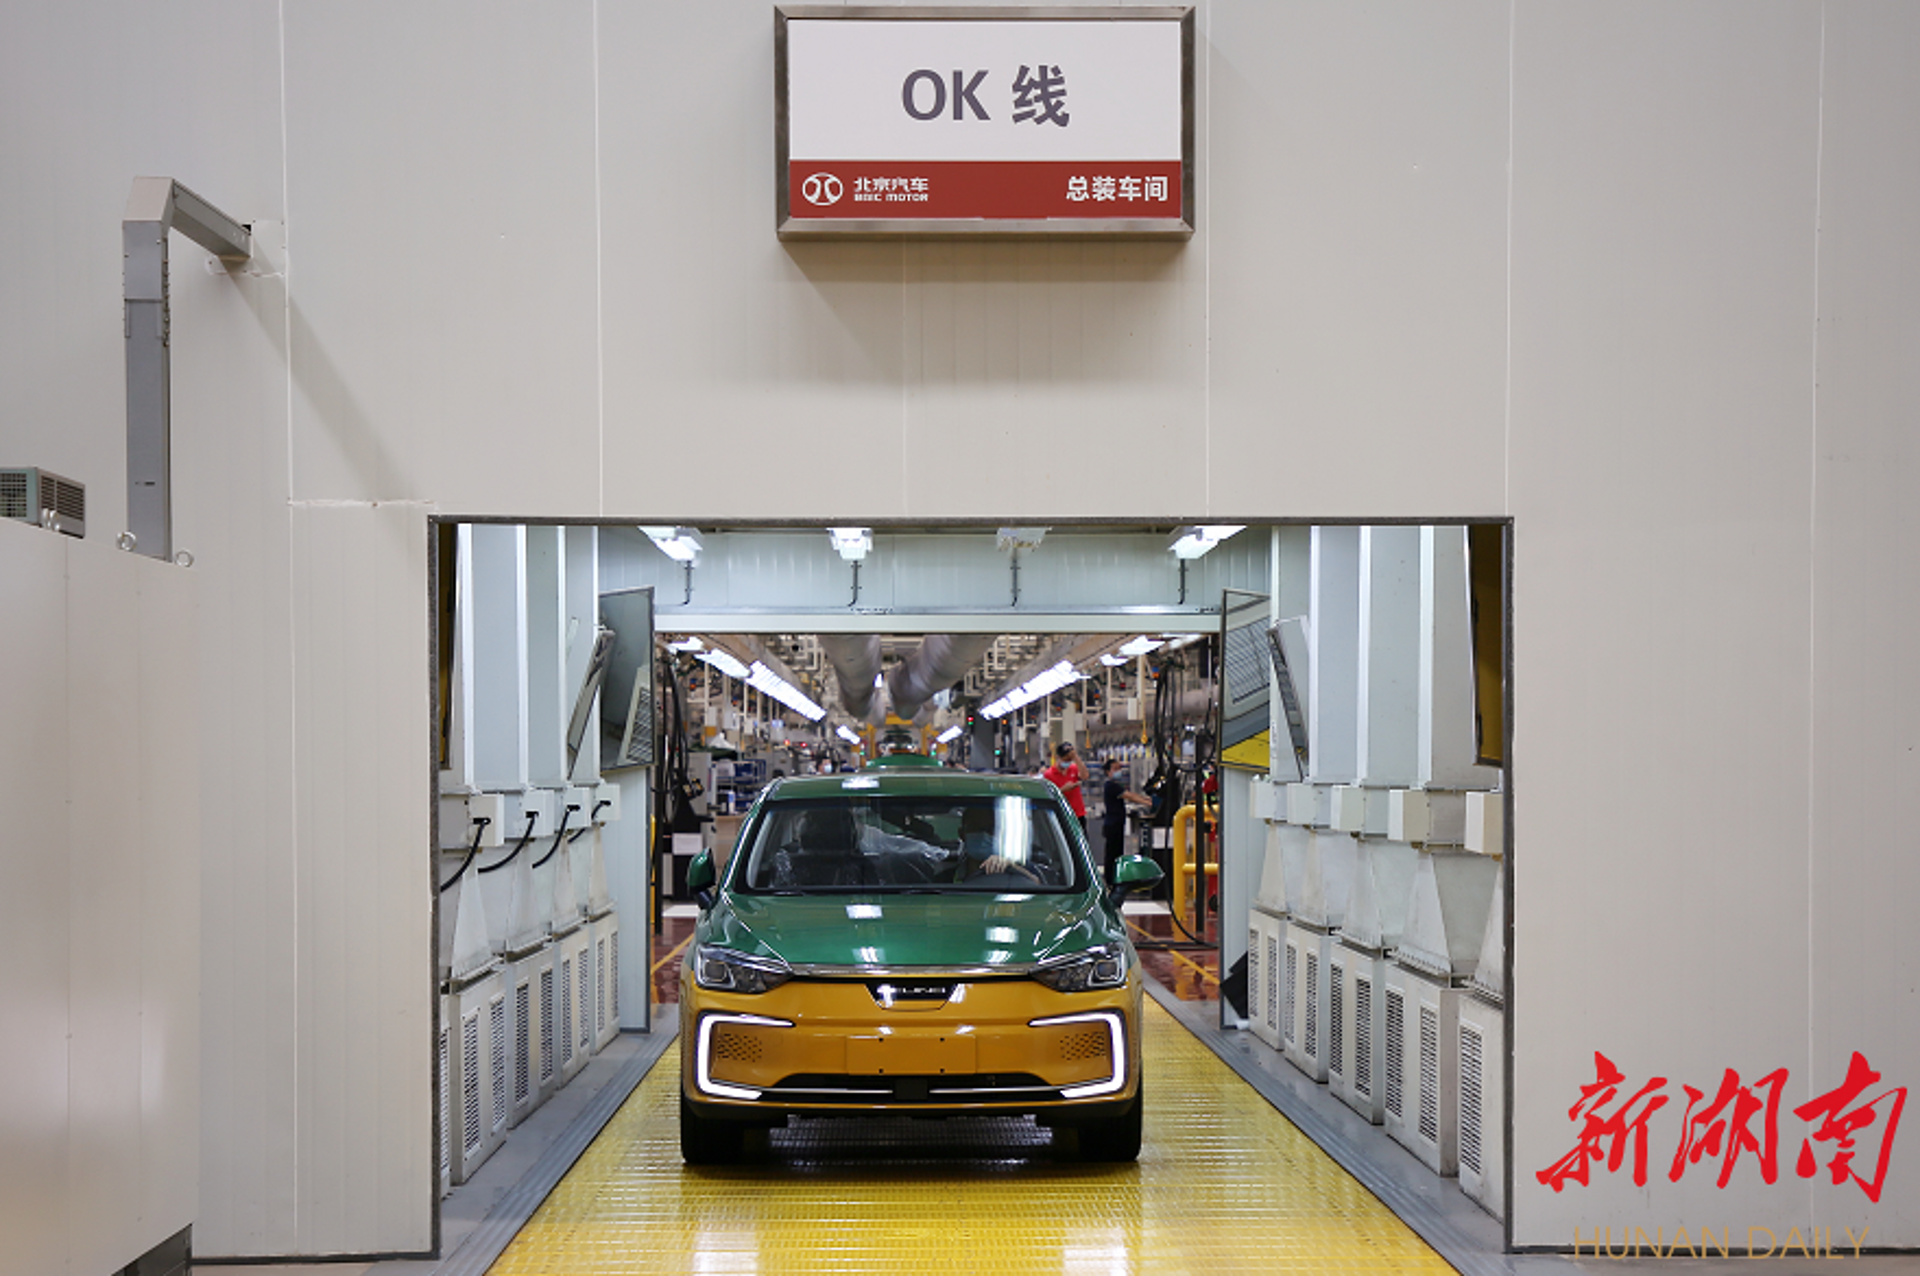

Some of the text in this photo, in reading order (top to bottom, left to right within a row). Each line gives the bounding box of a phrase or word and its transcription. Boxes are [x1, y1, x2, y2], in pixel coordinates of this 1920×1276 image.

[901, 64, 1070, 127] OK 线
[853, 176, 929, 193] 北京汽车
[1066, 175, 1169, 202] 总装车间
